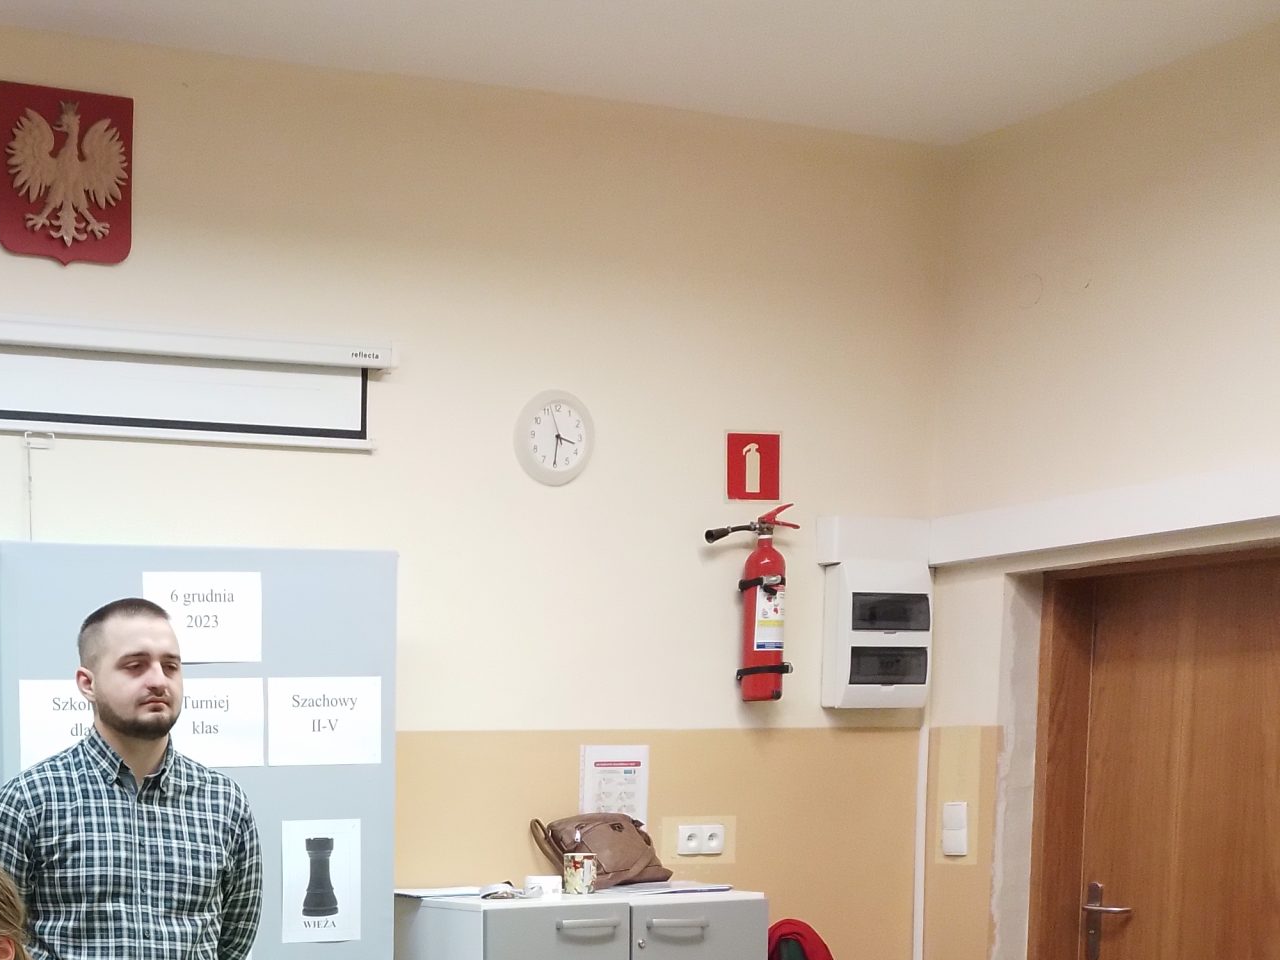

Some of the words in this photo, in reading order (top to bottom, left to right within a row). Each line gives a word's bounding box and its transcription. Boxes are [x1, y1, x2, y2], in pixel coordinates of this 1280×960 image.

[351, 351, 379, 360] reflecta
[170, 589, 179, 603] 6
[183, 588, 235, 606] grudnia
[186, 614, 219, 628] 2023
[52, 697, 91, 711] Szkol
[183, 695, 229, 712] Turniej
[291, 694, 358, 710] Szachowy
[70, 723, 91, 737] dla
[192, 721, 219, 734] klas
[311, 718, 339, 732] II-V
[303, 917, 337, 929] WIEŻA
